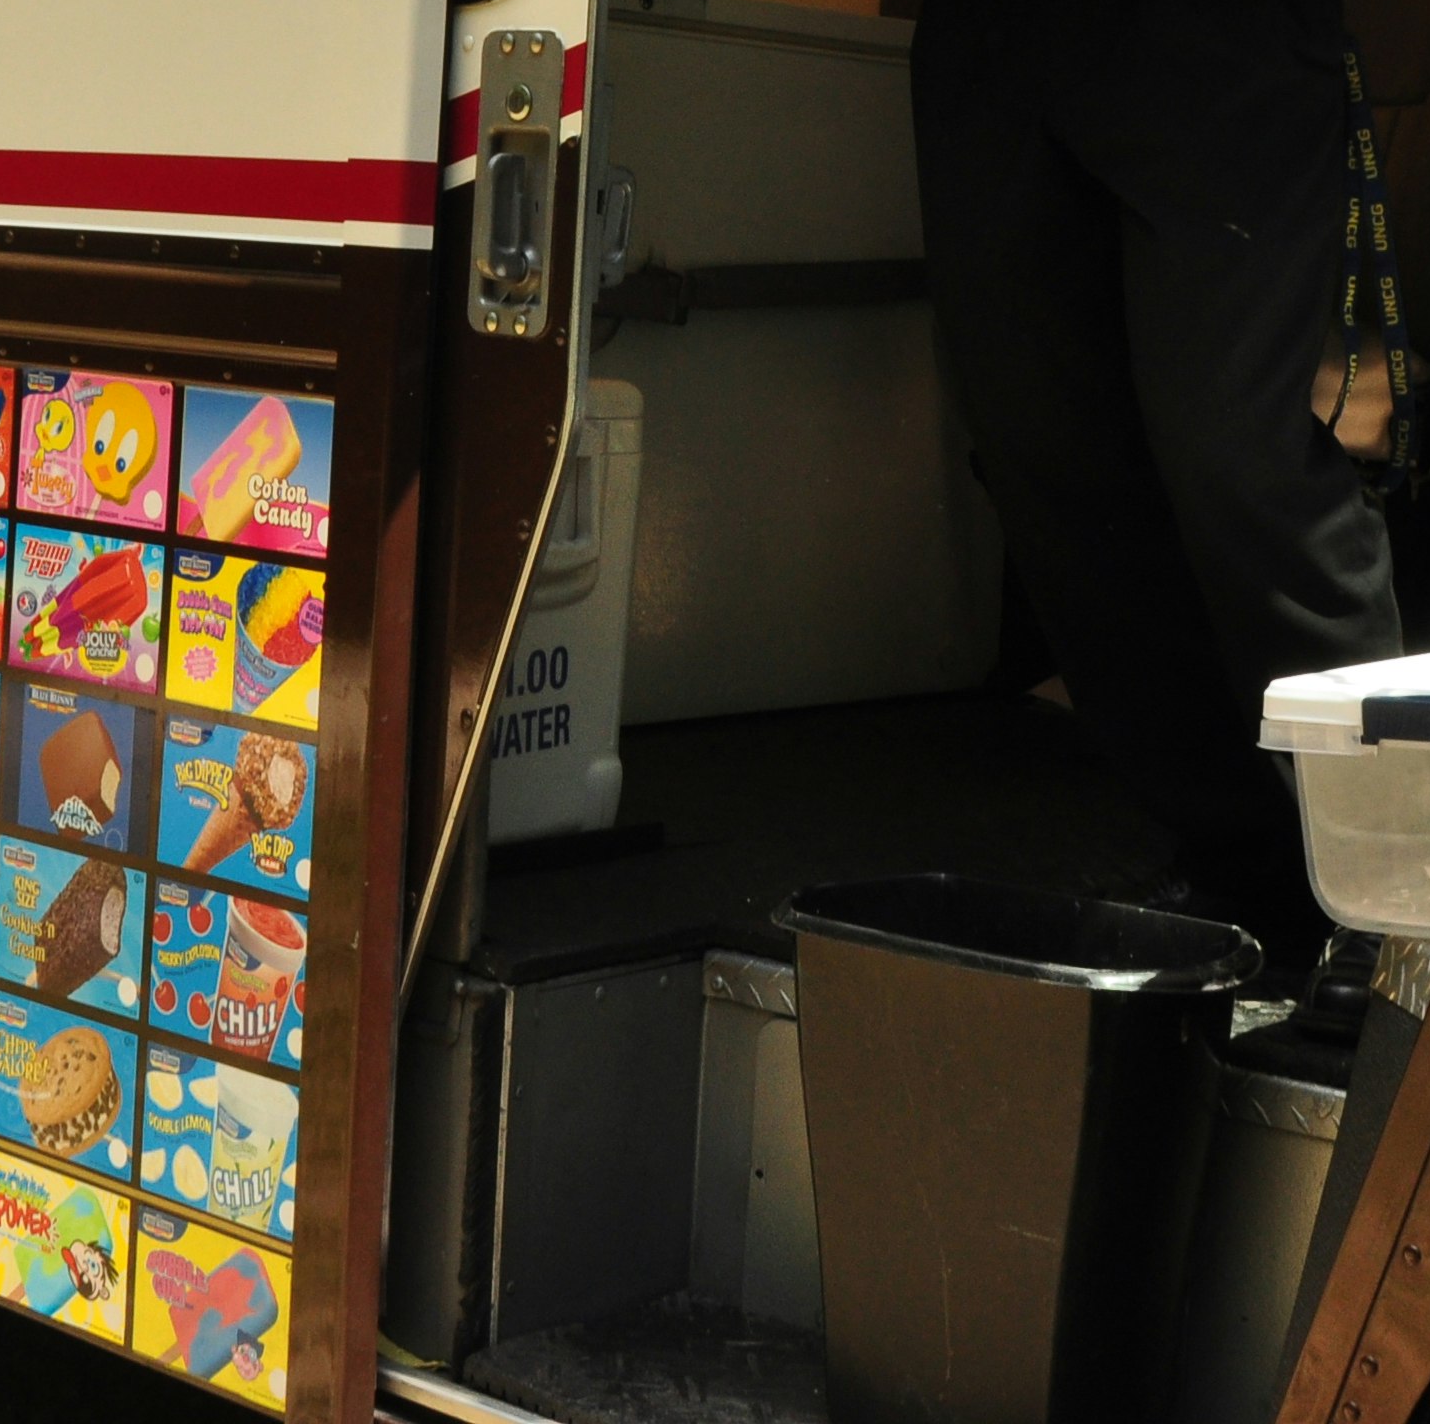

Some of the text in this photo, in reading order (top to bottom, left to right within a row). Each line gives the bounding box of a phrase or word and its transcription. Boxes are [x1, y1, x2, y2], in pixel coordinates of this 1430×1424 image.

[1344, 52, 1363, 102] UNCG
[1357, 128, 1378, 179] UNCG
[1345, 197, 1360, 249] UNCG
[1371, 203, 1388, 252] UNCG
[1380, 277, 1399, 325] UNCG
[1391, 349, 1408, 395] UNCG
[249, 473, 308, 504] Cotton
[253, 499, 312, 539] Candy
[23, 537, 72, 561] BOMB
[27, 559, 64, 578] POP
[85, 632, 117, 647] JOLLY
[31, 687, 75, 707] BLUE BUNNY
[64, 799, 87, 817] BIG
[50, 811, 101, 836] ALASKA
[14, 875, 40, 896] KING
[16, 891, 37, 909] SIZE
[0, 904, 43, 936] Cookies
[8, 934, 46, 962] Cream
[158, 949, 184, 968] CHERRY
[185, 944, 220, 966] EXPLOSION
[148, 1112, 212, 1134] DOUBLE LEMON
